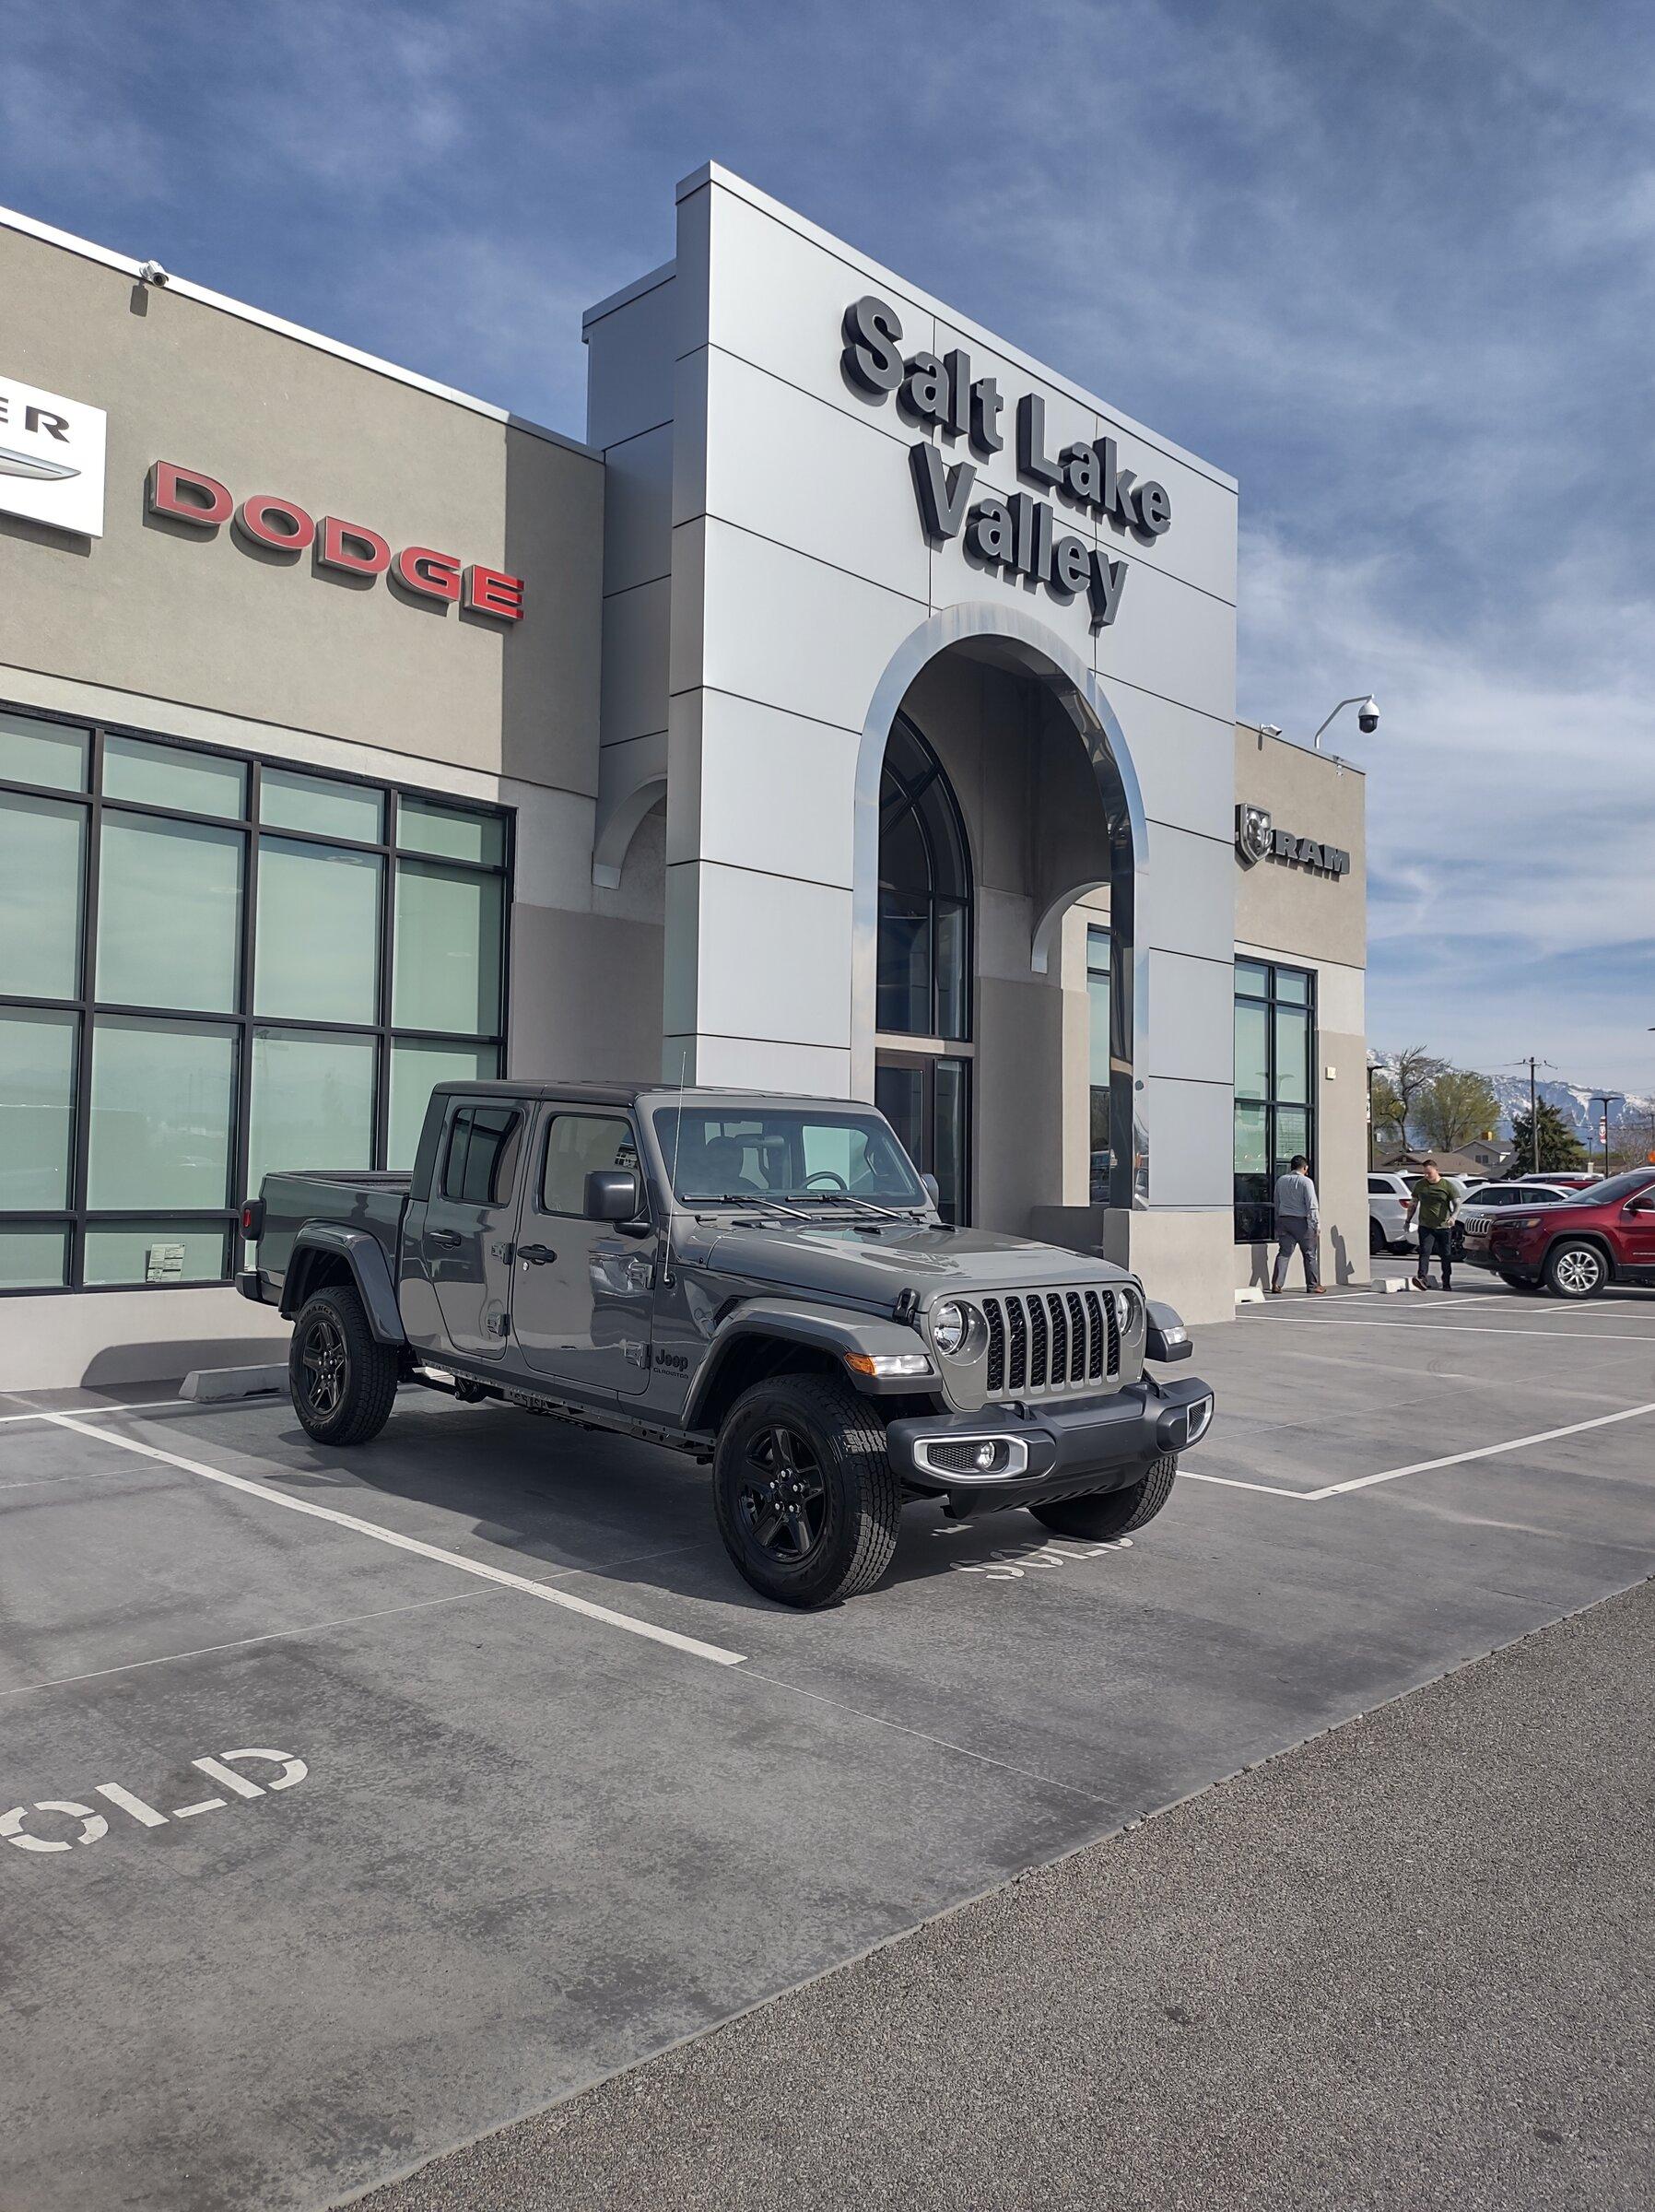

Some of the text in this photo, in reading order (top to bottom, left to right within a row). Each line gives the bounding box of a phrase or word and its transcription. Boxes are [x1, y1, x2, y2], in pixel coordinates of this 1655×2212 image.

[841, 295, 1171, 538] Salt Lake
[149, 460, 524, 620] DODGE
[909, 441, 1129, 627] Valley
[1271, 829, 1350, 875] RAM
[655, 1349, 688, 1372] Jeep
[0, 1747, 309, 1853] OLD
